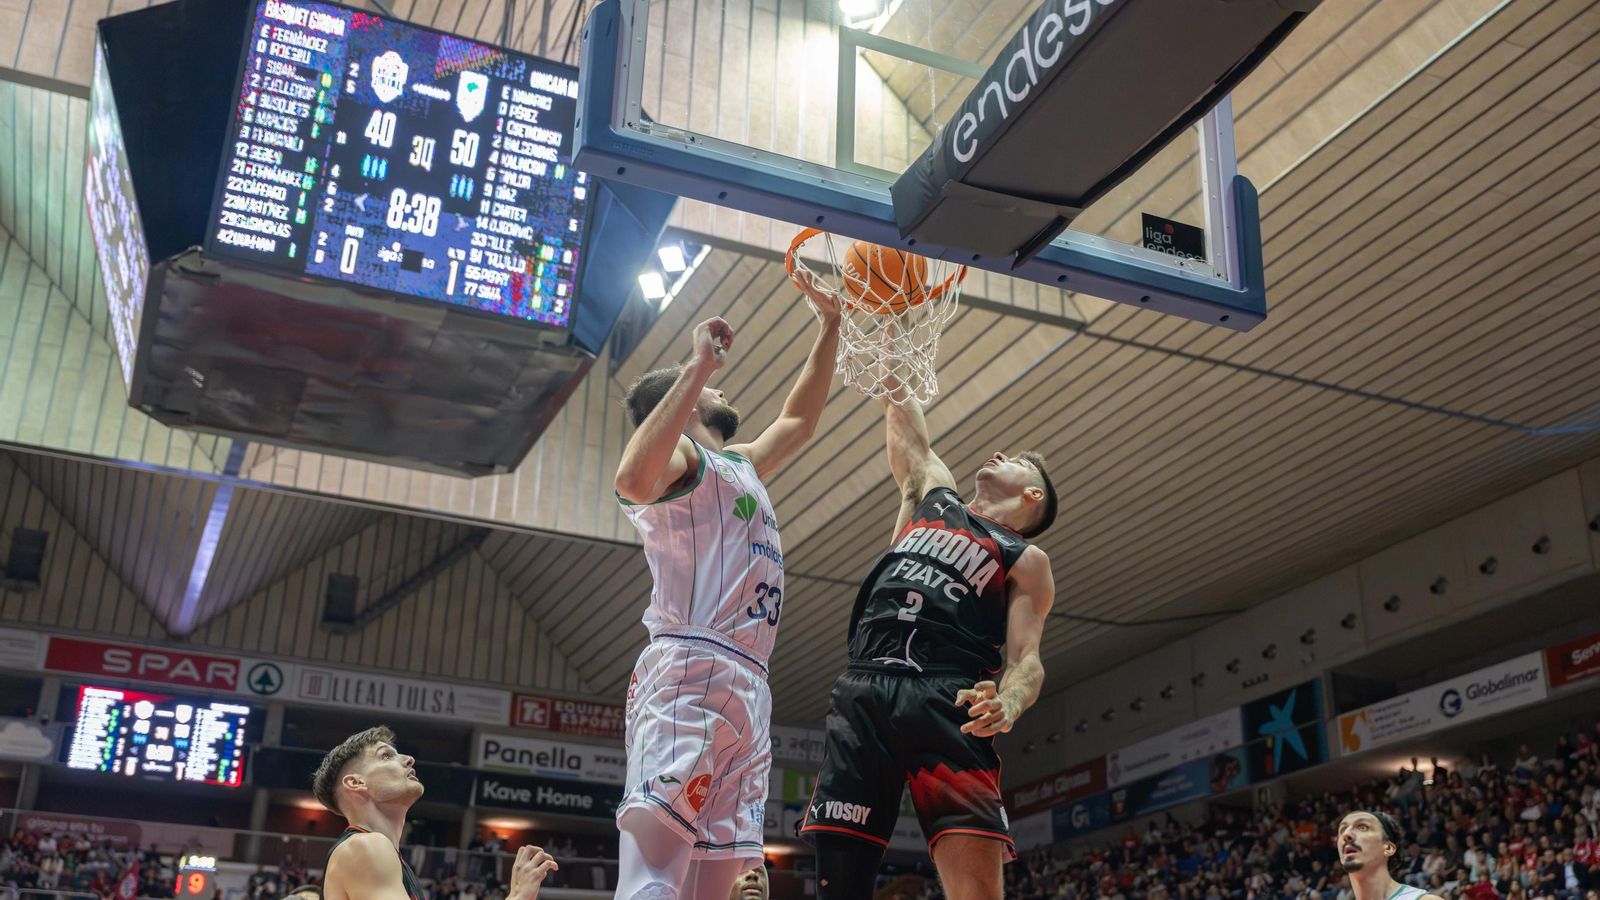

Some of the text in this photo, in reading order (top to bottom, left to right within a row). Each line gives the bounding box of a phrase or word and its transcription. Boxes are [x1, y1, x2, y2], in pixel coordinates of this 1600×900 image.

[953, 0, 1110, 162] endes
[364, 110, 396, 148] 40
[450, 128, 480, 168] 50
[386, 188, 442, 237] 8:38
[1146, 226, 1172, 244] liga
[340, 238, 360, 274] 0
[446, 260, 459, 296] 1
[894, 527, 1000, 597] GIRONA
[892, 558, 969, 603] FIATC
[747, 582, 782, 626] 33
[898, 591, 924, 622] 2
[103, 648, 238, 686] SPAR
[1466, 668, 1540, 701] Globalimar
[332, 676, 386, 707] LLEAL
[555, 700, 625, 718] EQUIPAC
[484, 740, 582, 770] Panella
[482, 781, 593, 808] Kave Home
[824, 801, 872, 826] YOSOY
[188, 872, 206, 894] 9
